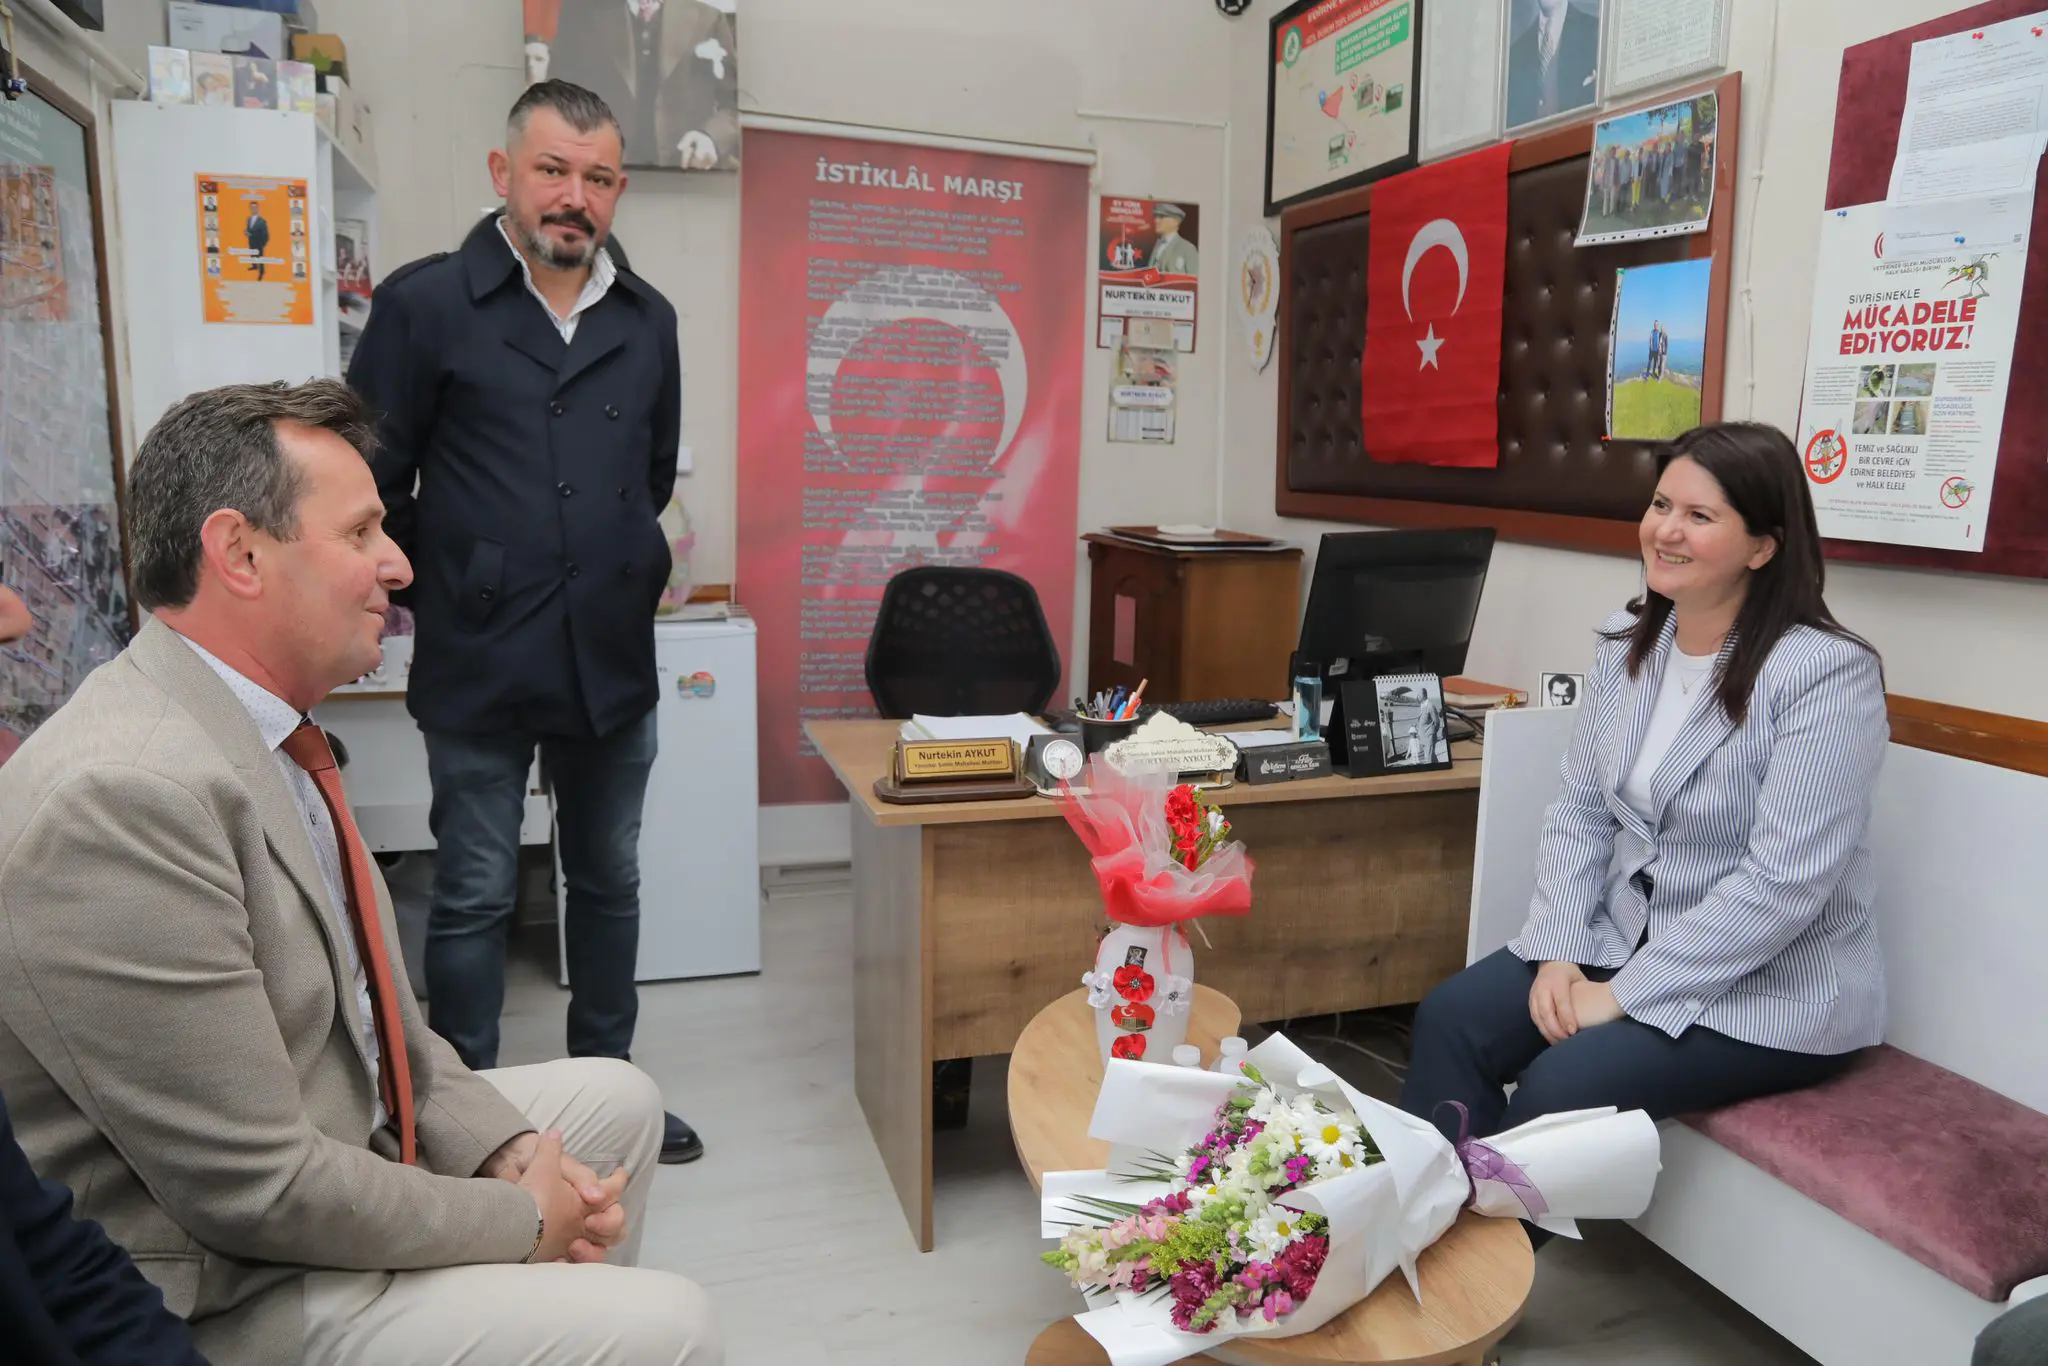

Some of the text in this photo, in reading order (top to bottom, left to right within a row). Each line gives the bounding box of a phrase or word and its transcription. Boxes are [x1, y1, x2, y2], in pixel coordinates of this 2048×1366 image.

[816, 157, 1024, 204] İSTİKLÂL MARŞI
[1105, 290, 1192, 304] NURTEKİN AYKUT
[1849, 288, 1920, 304] SİVRİSİNEKLE
[1843, 297, 1978, 330] MÜCADELE
[1839, 324, 1974, 355] EDİYORUZ!
[1855, 444, 1875, 453] TEMİZ
[1886, 443, 1919, 454] SAĞLIKLI
[1858, 456, 1871, 465] BİR
[1850, 467, 1916, 479] EDİRNE BELEDİYESİ
[1866, 480, 1885, 489] HALK
[1886, 481, 1906, 491] ELELE
[918, 748, 997, 761] Nurtekin AYKUT
[1183, 754, 1212, 763] AYKUT
